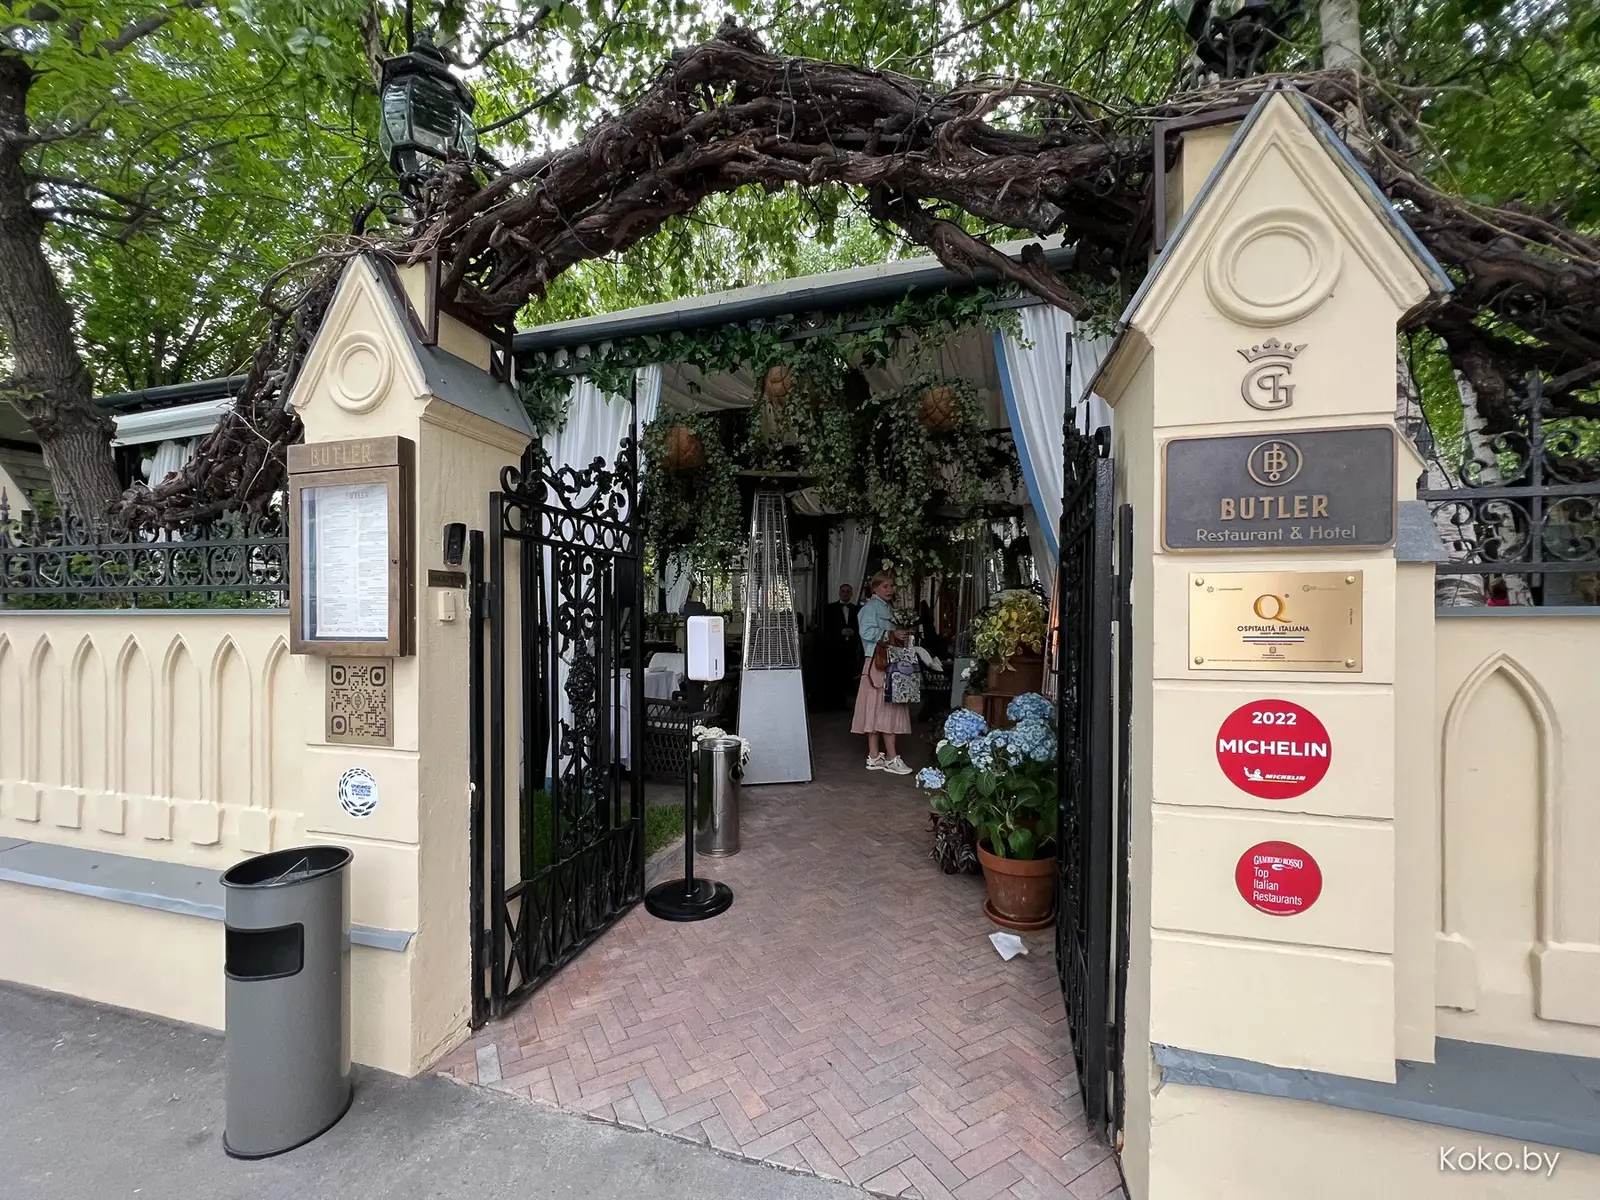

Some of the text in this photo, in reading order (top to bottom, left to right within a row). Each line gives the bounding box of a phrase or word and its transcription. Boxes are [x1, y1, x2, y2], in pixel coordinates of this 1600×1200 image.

[311, 443, 373, 466] BUTLER
[1220, 494, 1330, 521] BUTLER
[1196, 525, 1356, 542] Restaurant & Hotel
[1251, 711, 1297, 726] 2022
[1219, 738, 1327, 758] MICHELIN
[1264, 773, 1306, 781] MICHELIN
[1282, 857, 1303, 869] ROSSO
[1253, 866, 1269, 879] Top
[1253, 878, 1279, 891] Italian
[1252, 890, 1303, 906] Restaurants
